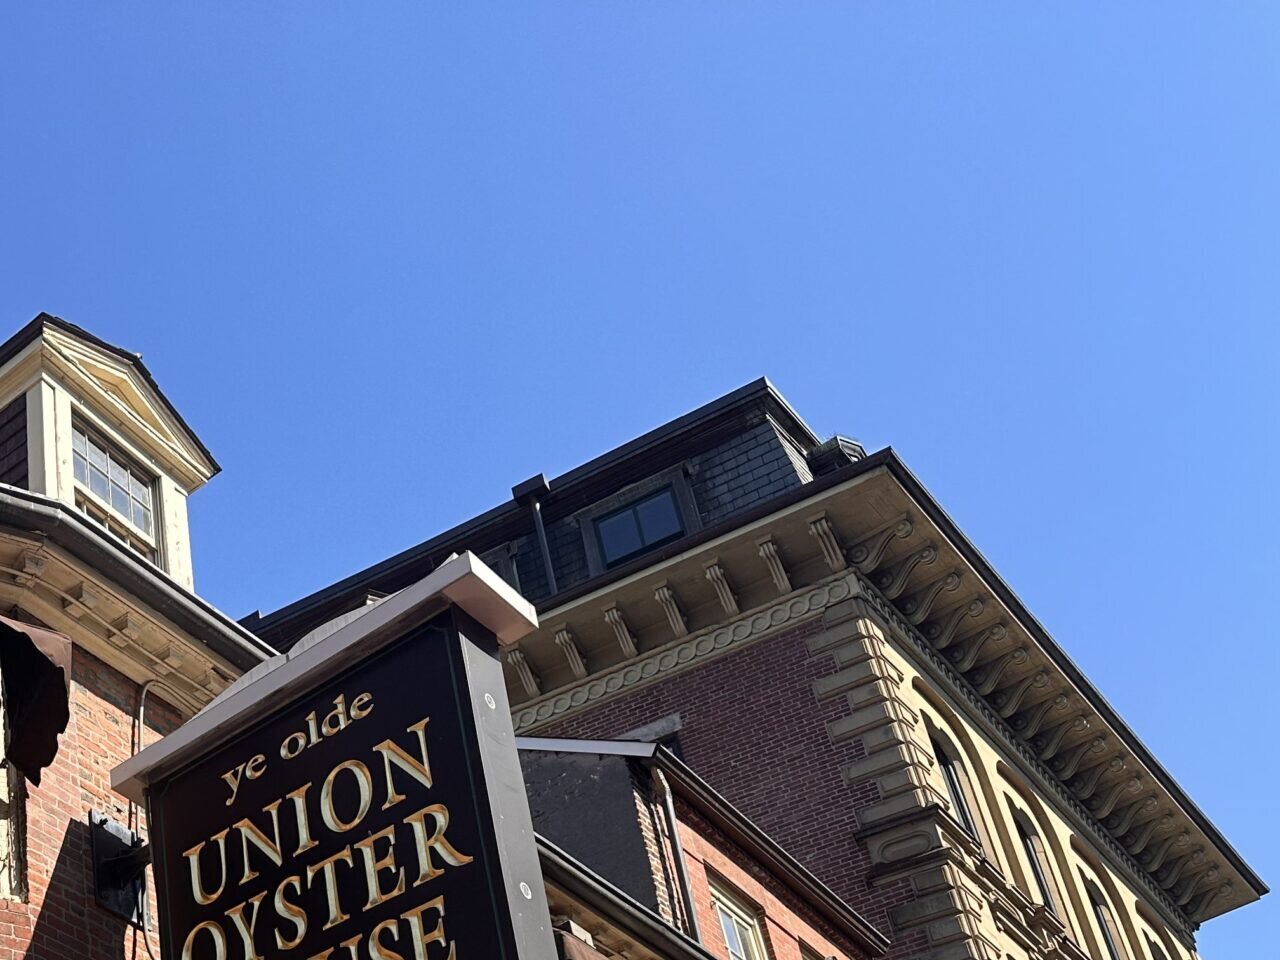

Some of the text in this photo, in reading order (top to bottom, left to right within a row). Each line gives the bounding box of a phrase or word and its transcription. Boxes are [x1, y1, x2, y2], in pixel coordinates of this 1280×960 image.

[182, 717, 434, 905] UNION
[221, 690, 374, 806] ye olde
